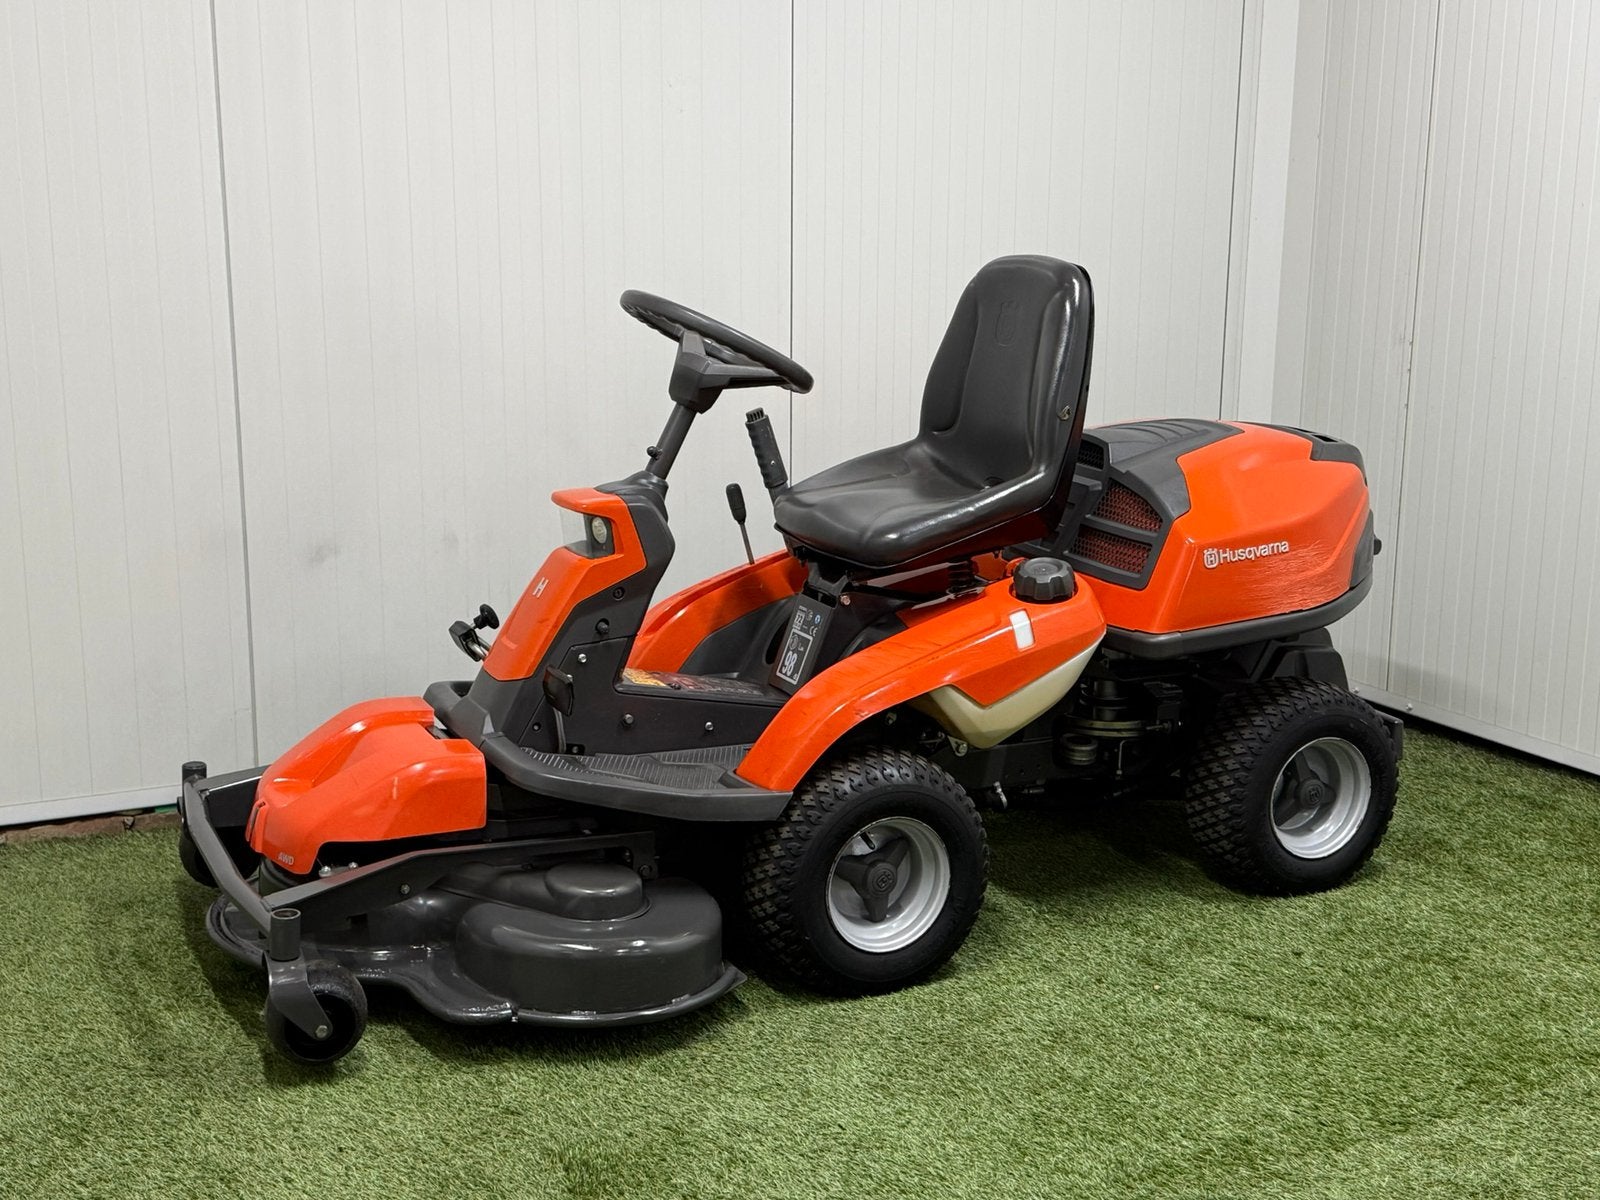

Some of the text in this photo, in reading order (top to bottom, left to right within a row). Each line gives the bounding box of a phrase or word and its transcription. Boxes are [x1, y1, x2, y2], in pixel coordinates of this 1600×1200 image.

[1219, 540, 1290, 564] Husqvarna
[781, 650, 798, 677] 98
[278, 851, 295, 866] AWD
